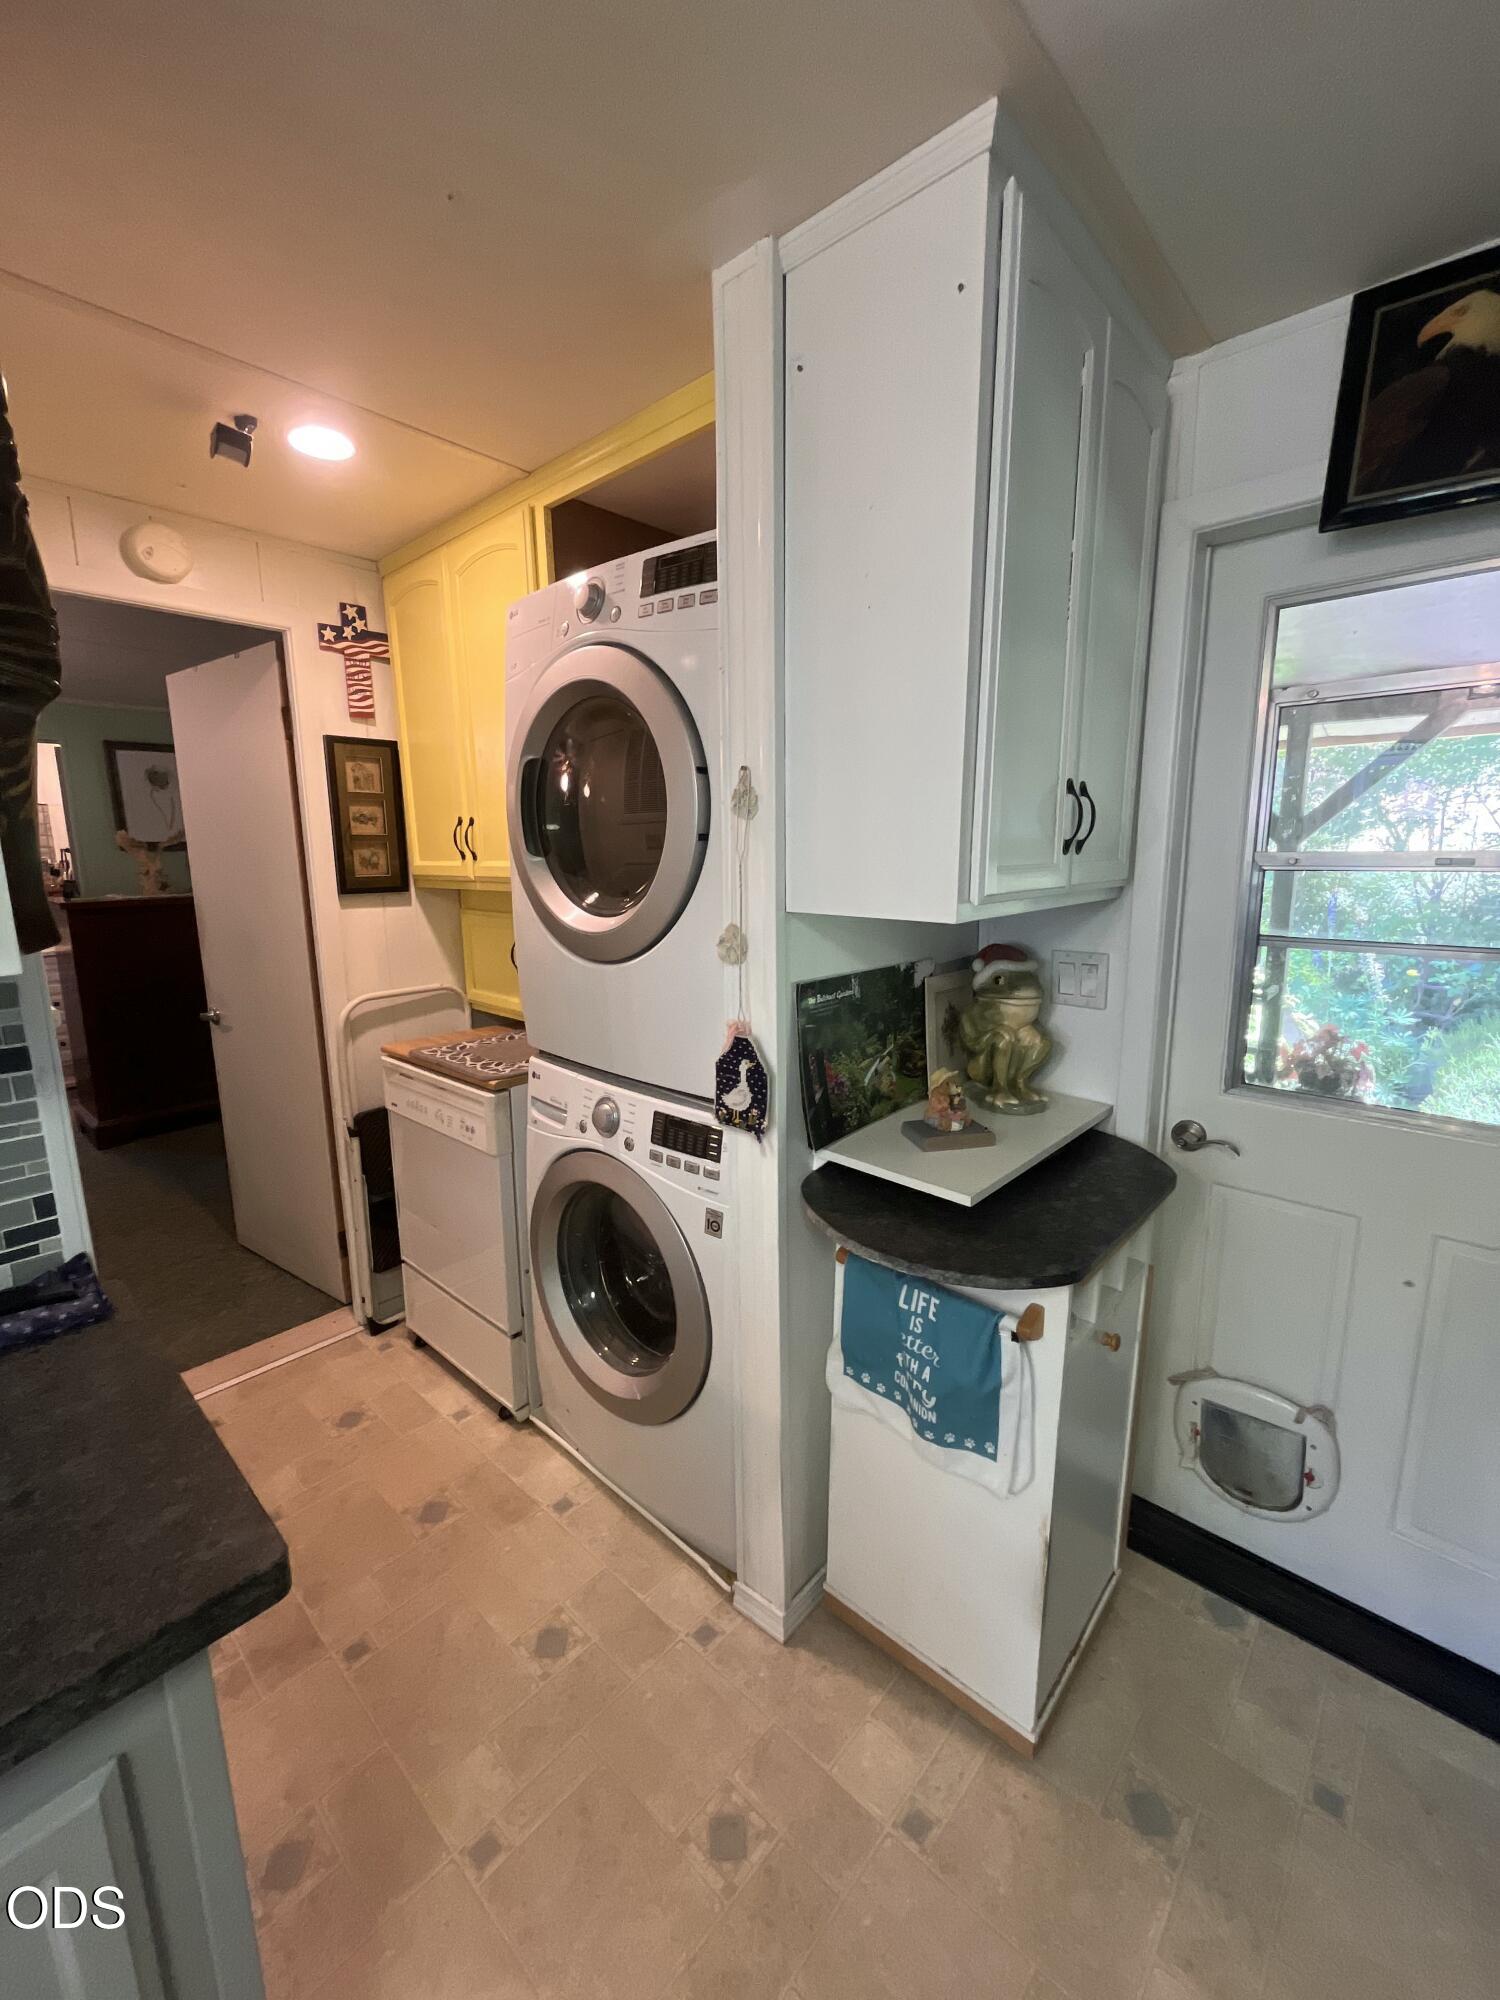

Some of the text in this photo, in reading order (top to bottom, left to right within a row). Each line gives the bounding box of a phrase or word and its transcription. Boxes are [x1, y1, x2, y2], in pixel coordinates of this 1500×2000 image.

[898, 1284, 940, 1323] LIFE
[909, 1315, 924, 1334] IS
[921, 1366, 931, 1383] A
